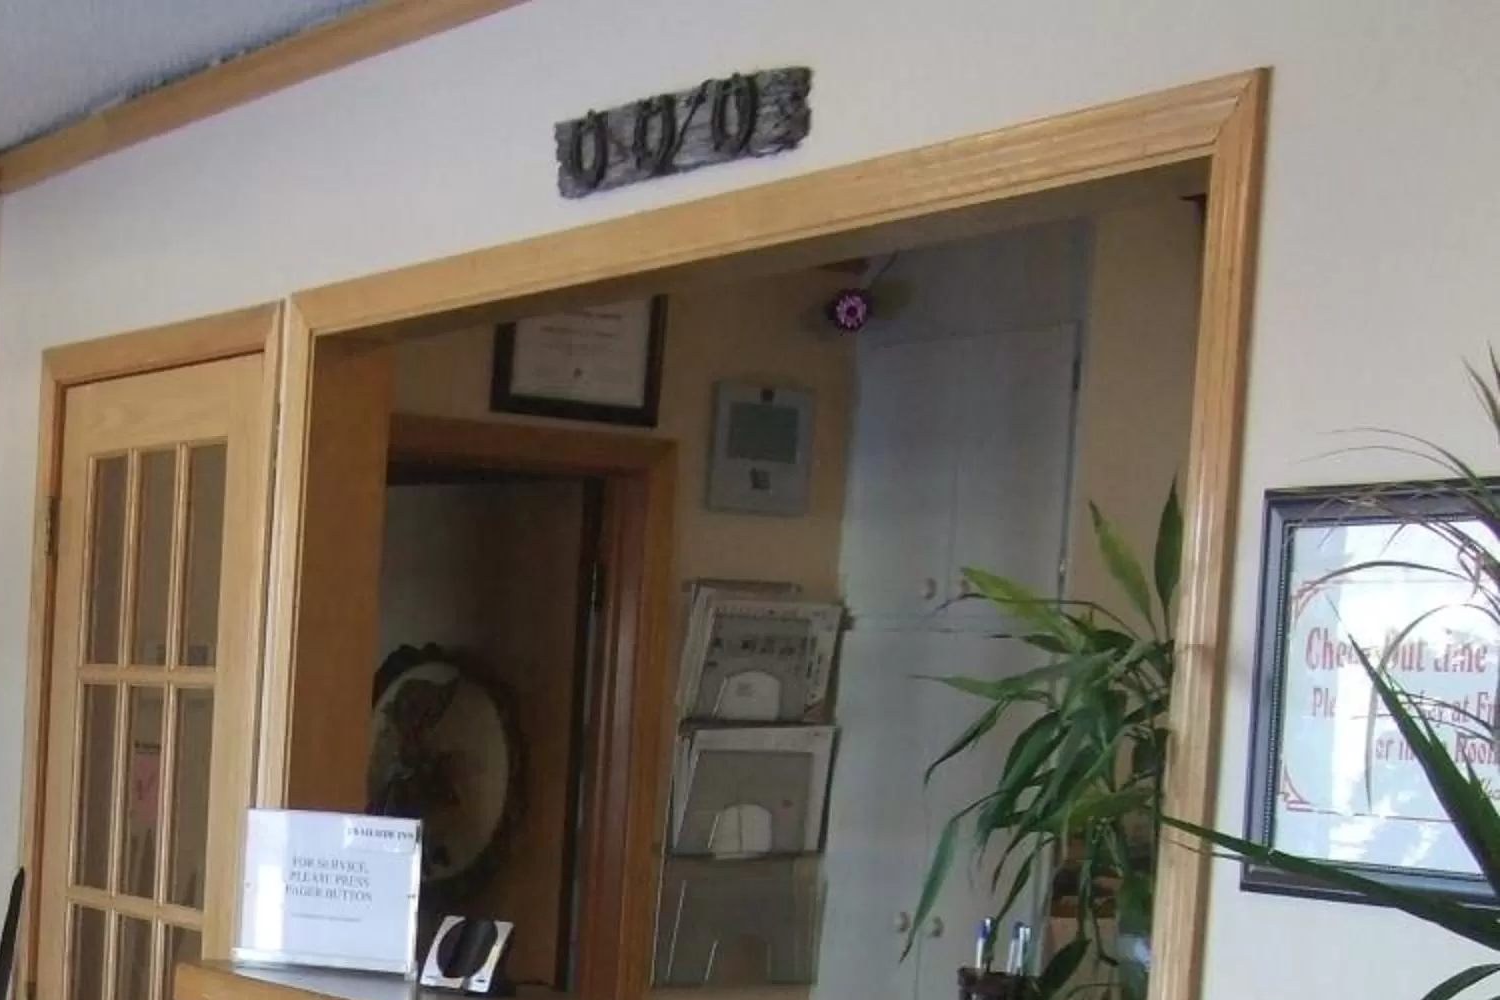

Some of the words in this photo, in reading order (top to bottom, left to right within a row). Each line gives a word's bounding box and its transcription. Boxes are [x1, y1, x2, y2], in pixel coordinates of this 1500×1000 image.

[291, 855, 315, 869] FOR
[288, 871, 332, 886] PLEASE
[334, 874, 370, 889] PRESS
[285, 883, 324, 898] PAGER
[325, 887, 373, 903] BUTTON
